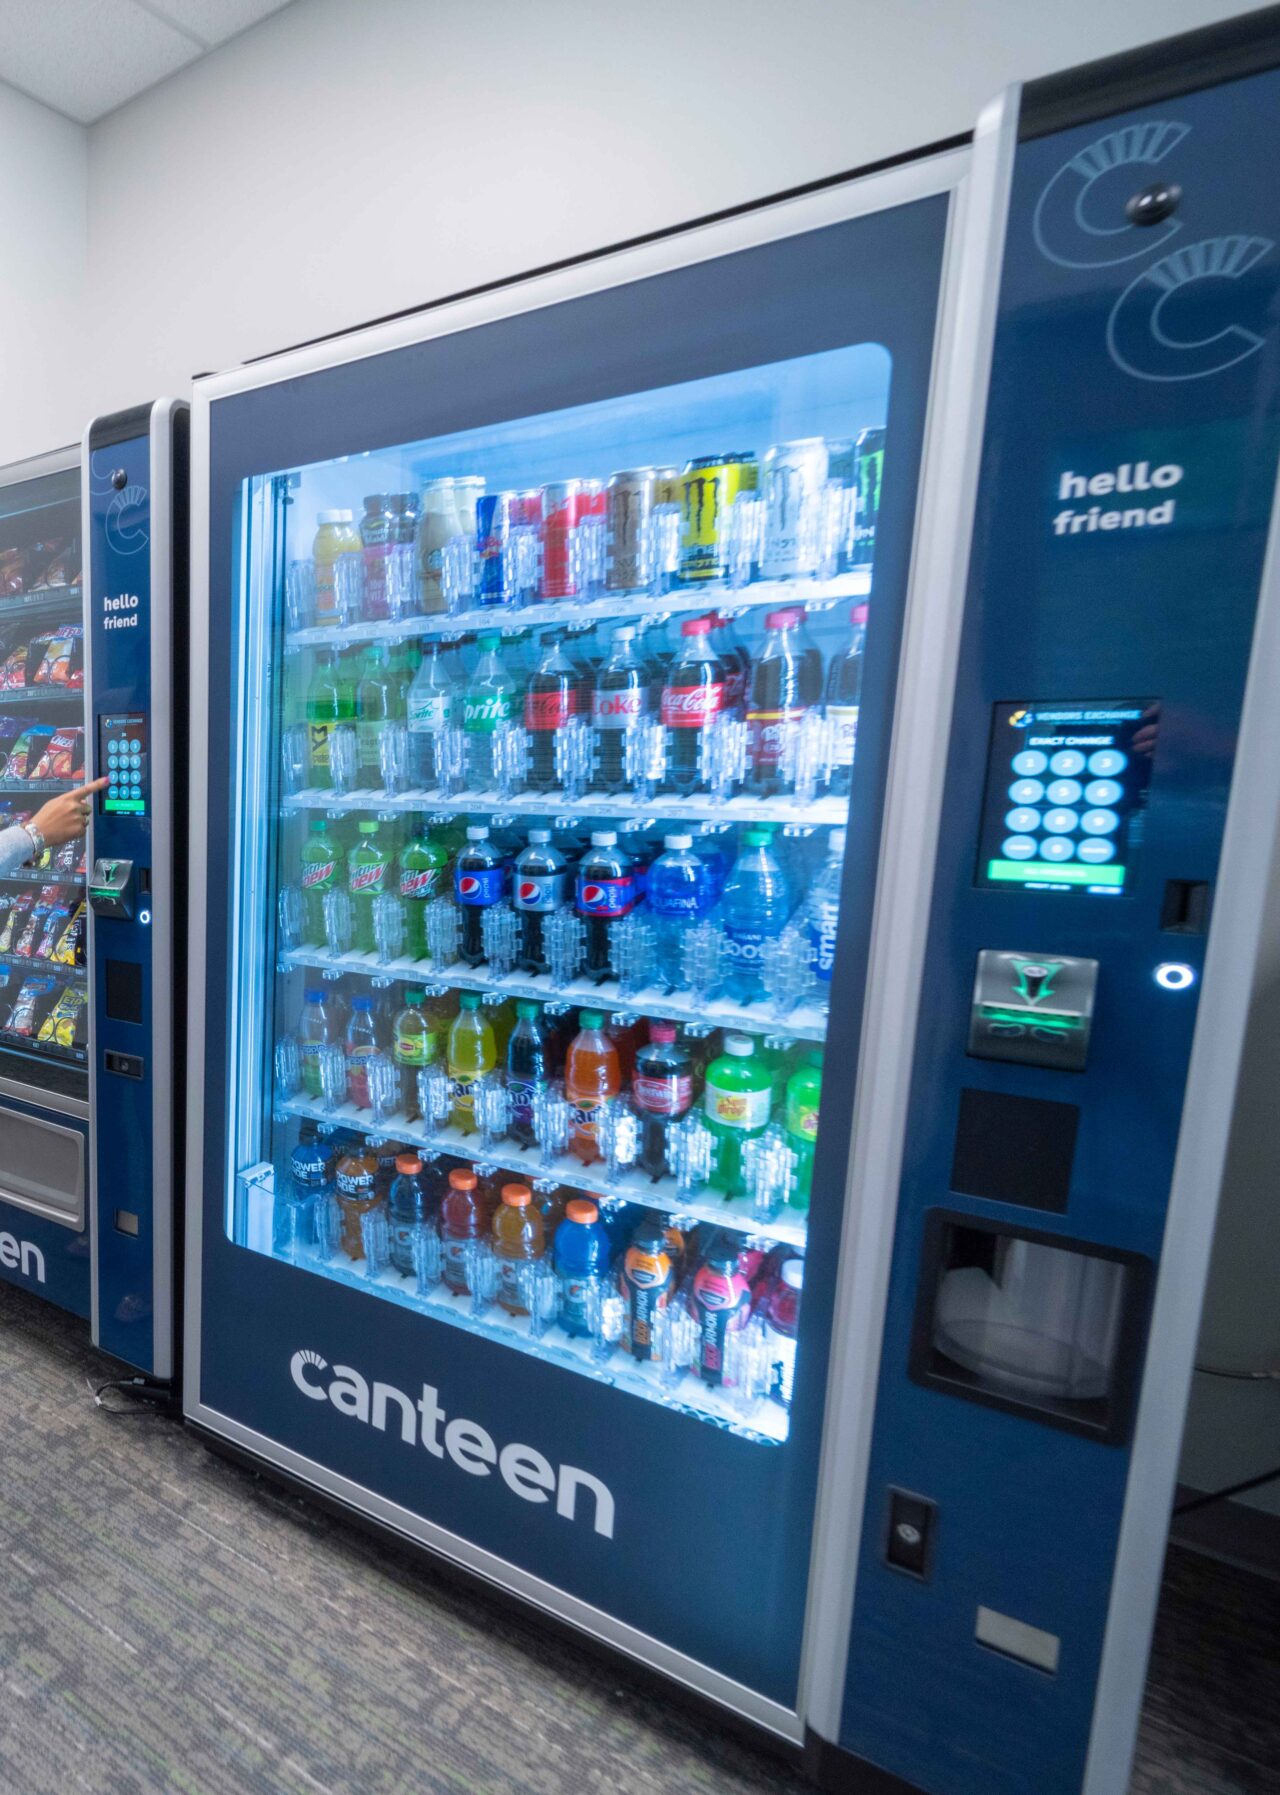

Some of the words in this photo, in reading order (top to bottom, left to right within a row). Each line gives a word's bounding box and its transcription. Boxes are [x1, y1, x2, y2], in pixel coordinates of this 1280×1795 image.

[1057, 461, 1184, 500] hello
[1052, 499, 1177, 535] friend
[103, 594, 139, 611] hello
[103, 613, 138, 630] friend
[464, 698, 511, 723] prite
[1025, 757, 1035, 768] 1
[1061, 758, 1073, 768] 2
[1101, 757, 1113, 768] 3
[1021, 787, 1033, 796] 4
[1058, 787, 1069, 797] 5
[1097, 787, 1108, 797] 6
[1019, 814, 1029, 824] 7
[1055, 815, 1066, 826] 8
[1093, 816, 1105, 826] 9
